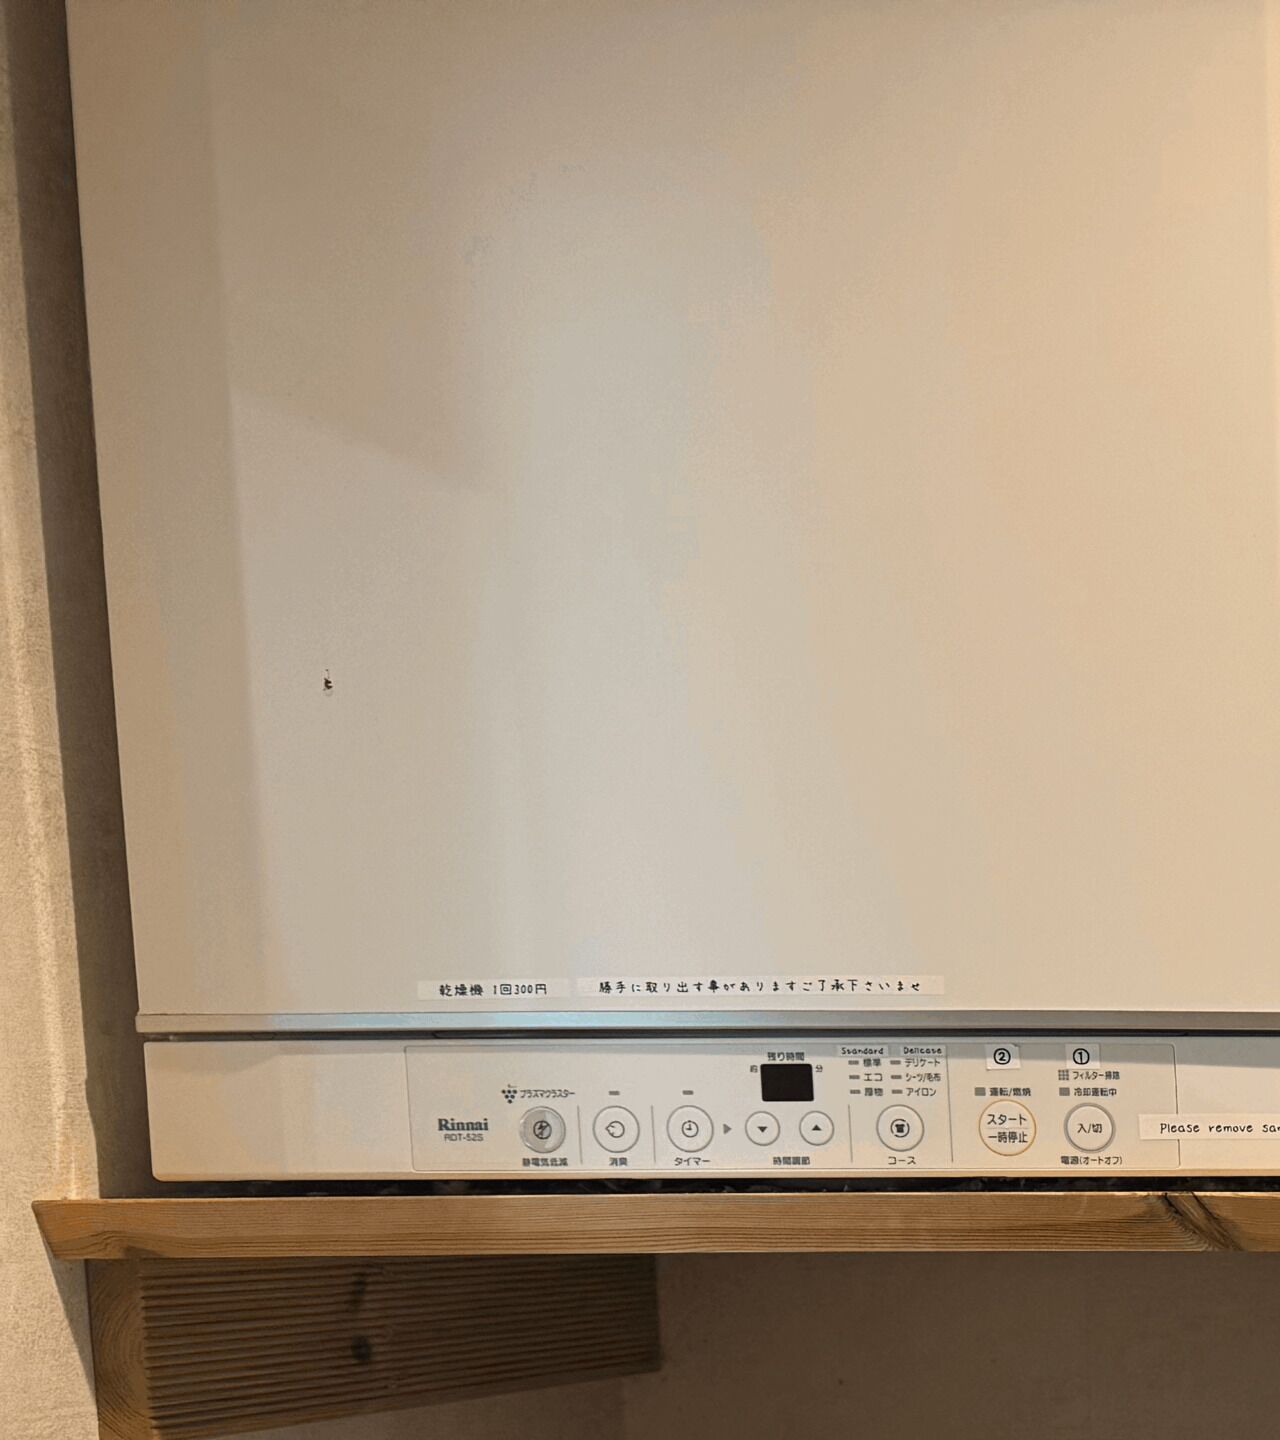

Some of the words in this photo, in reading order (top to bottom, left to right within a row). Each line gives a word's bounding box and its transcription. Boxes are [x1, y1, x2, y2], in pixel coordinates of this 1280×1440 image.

[439, 984, 484, 997] 乾燥機
[493, 983, 548, 996] 1回300円
[841, 1046, 884, 1056] Standard
[903, 1046, 943, 1055] Delicate
[767, 1051, 805, 1062] 残り時間
[905, 1058, 941, 1067] デリケート
[864, 1073, 883, 1082] エコ
[905, 1072, 942, 1082] シーツ/毛布
[519, 1089, 576, 1099] プラズマクラスター
[906, 1088, 937, 1097] アイロン
[1073, 1087, 1117, 1097] 冷却運転中
[437, 1118, 489, 1131] Rinnai
[986, 1113, 1028, 1126] スタート
[1077, 1122, 1103, 1134] 入/切
[1159, 1122, 1201, 1134] Please
[1208, 1123, 1253, 1134] remove
[443, 1133, 484, 1142] RDT-52S
[987, 1131, 1028, 1144] 一時停止
[674, 1157, 710, 1166] タイマー
[773, 1156, 811, 1166] 時間調節
[888, 1156, 917, 1165] コース
[1060, 1155, 1123, 1166] 電源(オートオフ)
